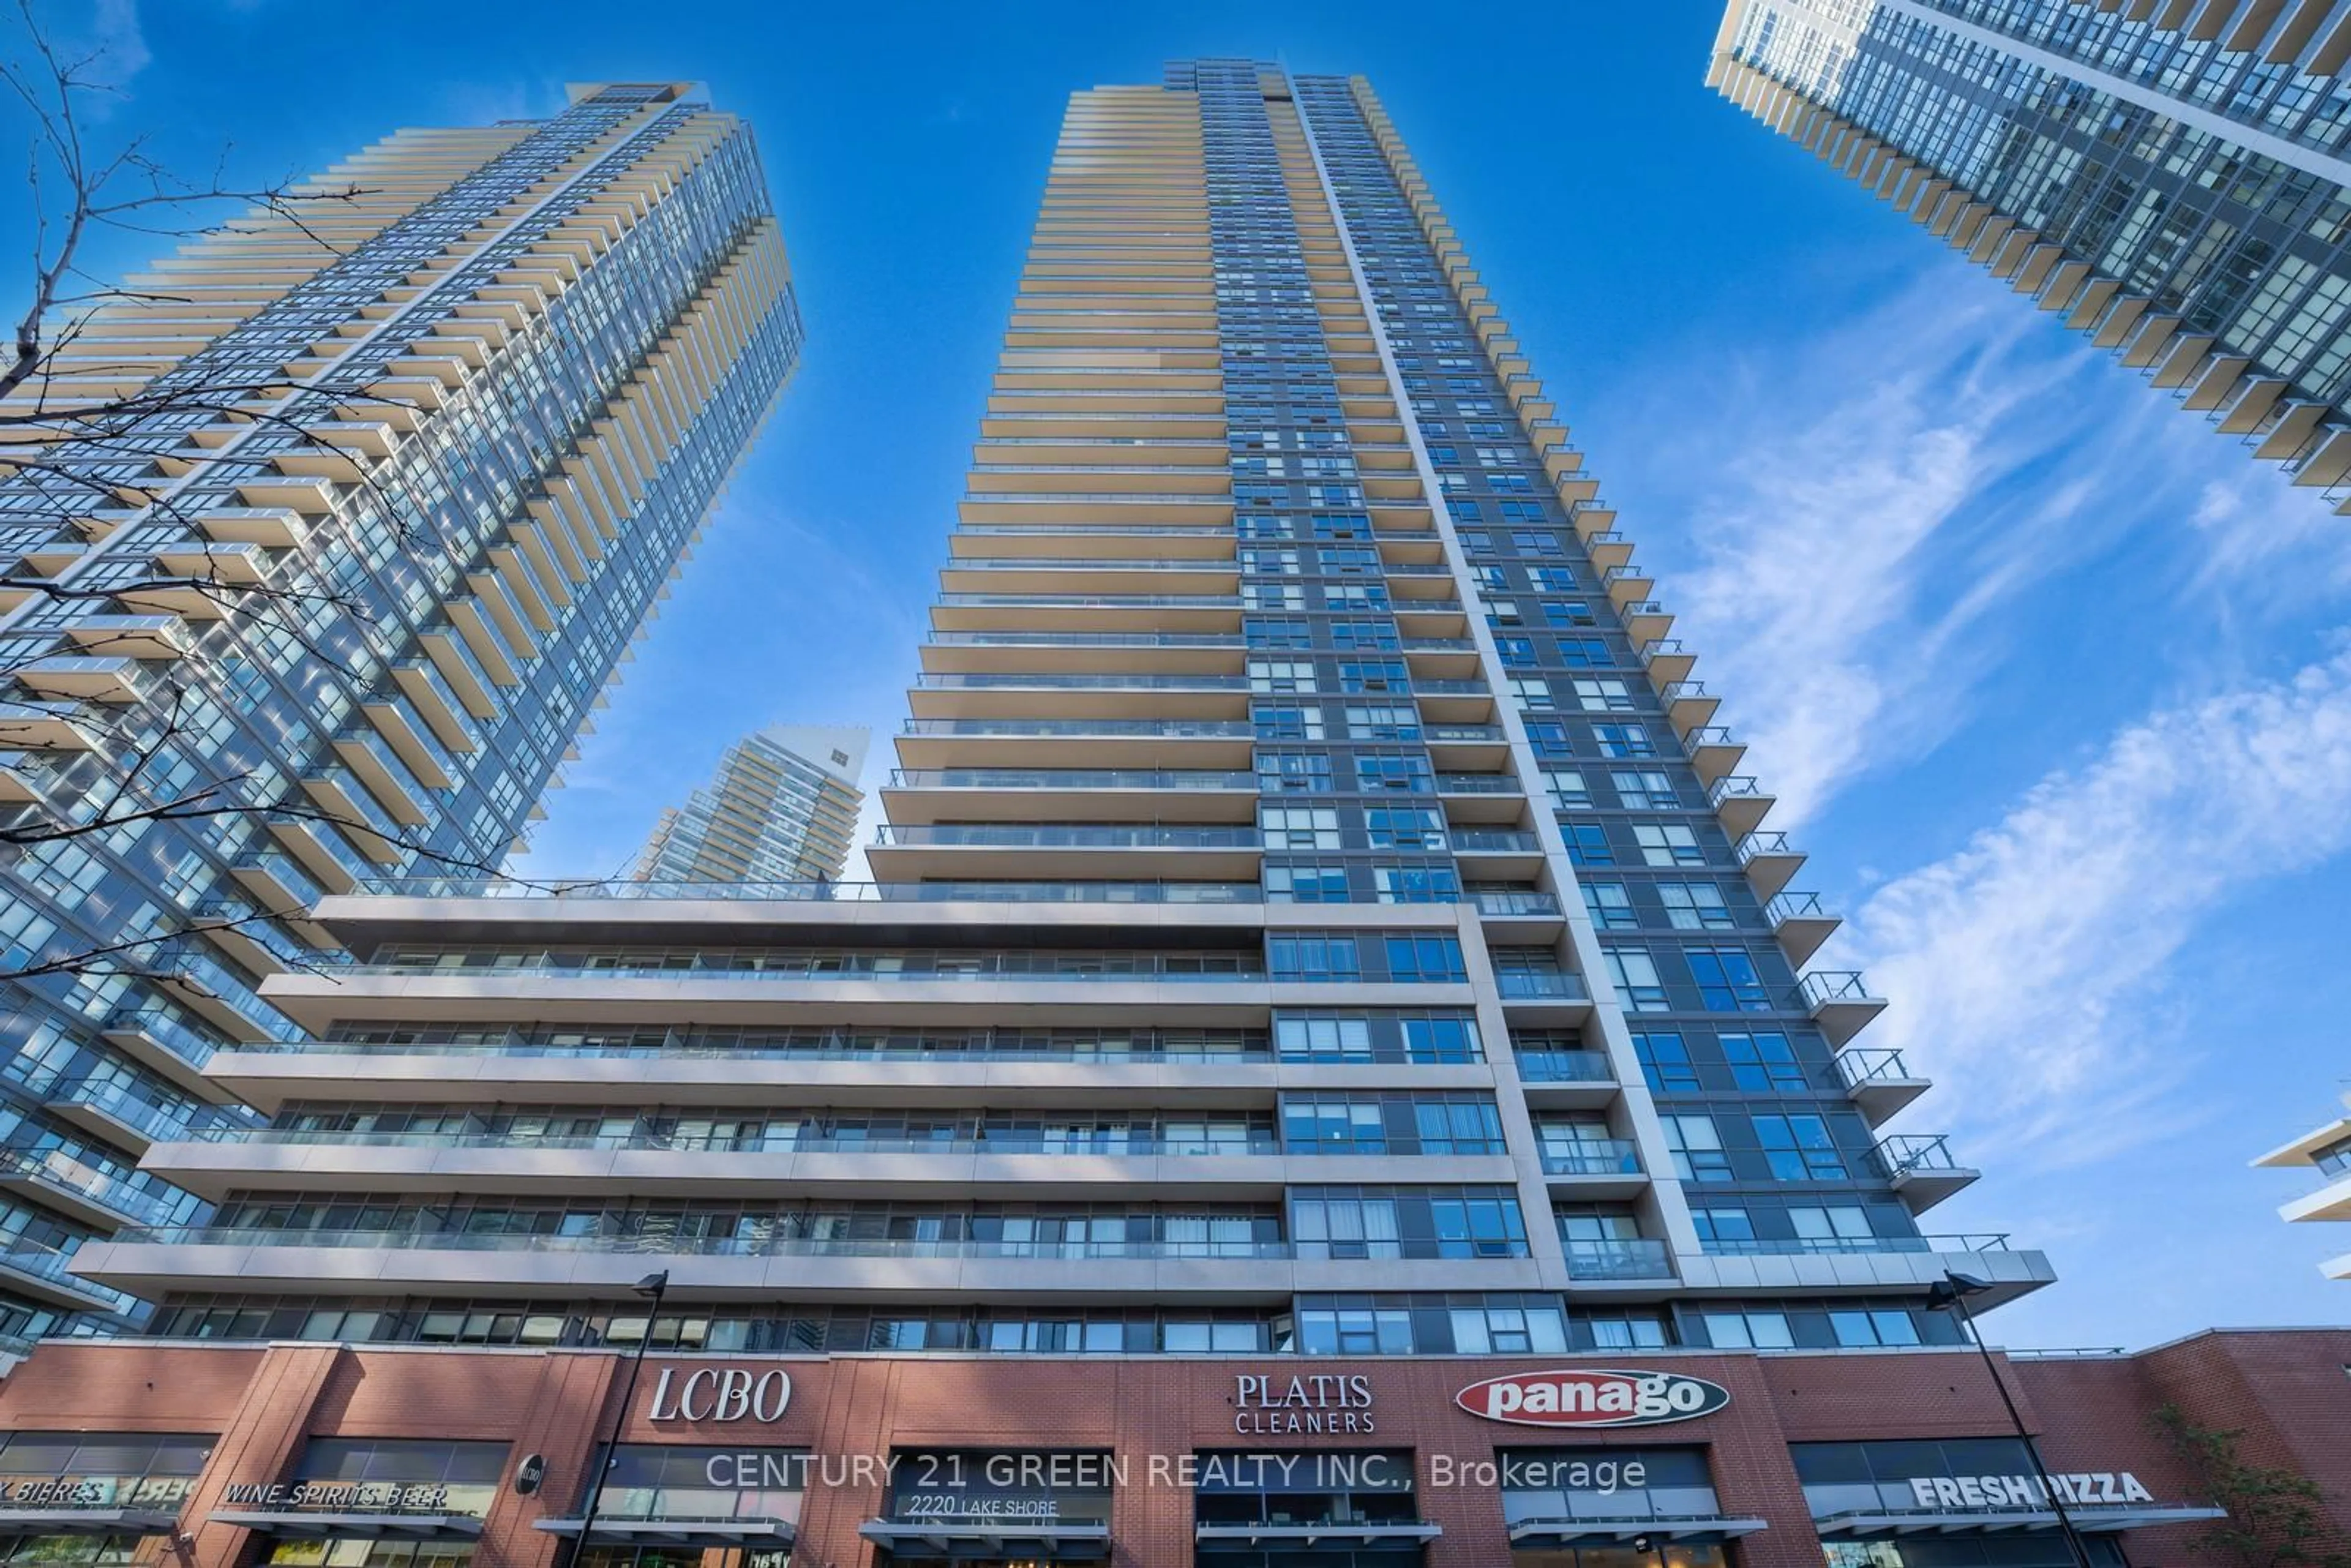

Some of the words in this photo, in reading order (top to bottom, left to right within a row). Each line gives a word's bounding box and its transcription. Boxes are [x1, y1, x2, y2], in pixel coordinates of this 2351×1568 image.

[648, 1368, 791, 1423] LCBO
[1235, 1375, 1372, 1408] PLATIS
[1487, 1372, 1706, 1418] panago
[1235, 1412, 1374, 1434] CLEANERS
[225, 1484, 284, 1504] WINE
[289, 1484, 380, 1506] SPIRITS
[385, 1486, 448, 1507] BEER
[910, 1495, 954, 1514] 2220
[962, 1500, 1001, 1515] LAKE
[1005, 1500, 1057, 1515] SHORE
[1910, 1475, 2035, 1507] FRESH
[2035, 1472, 2154, 1504] PIZZA
